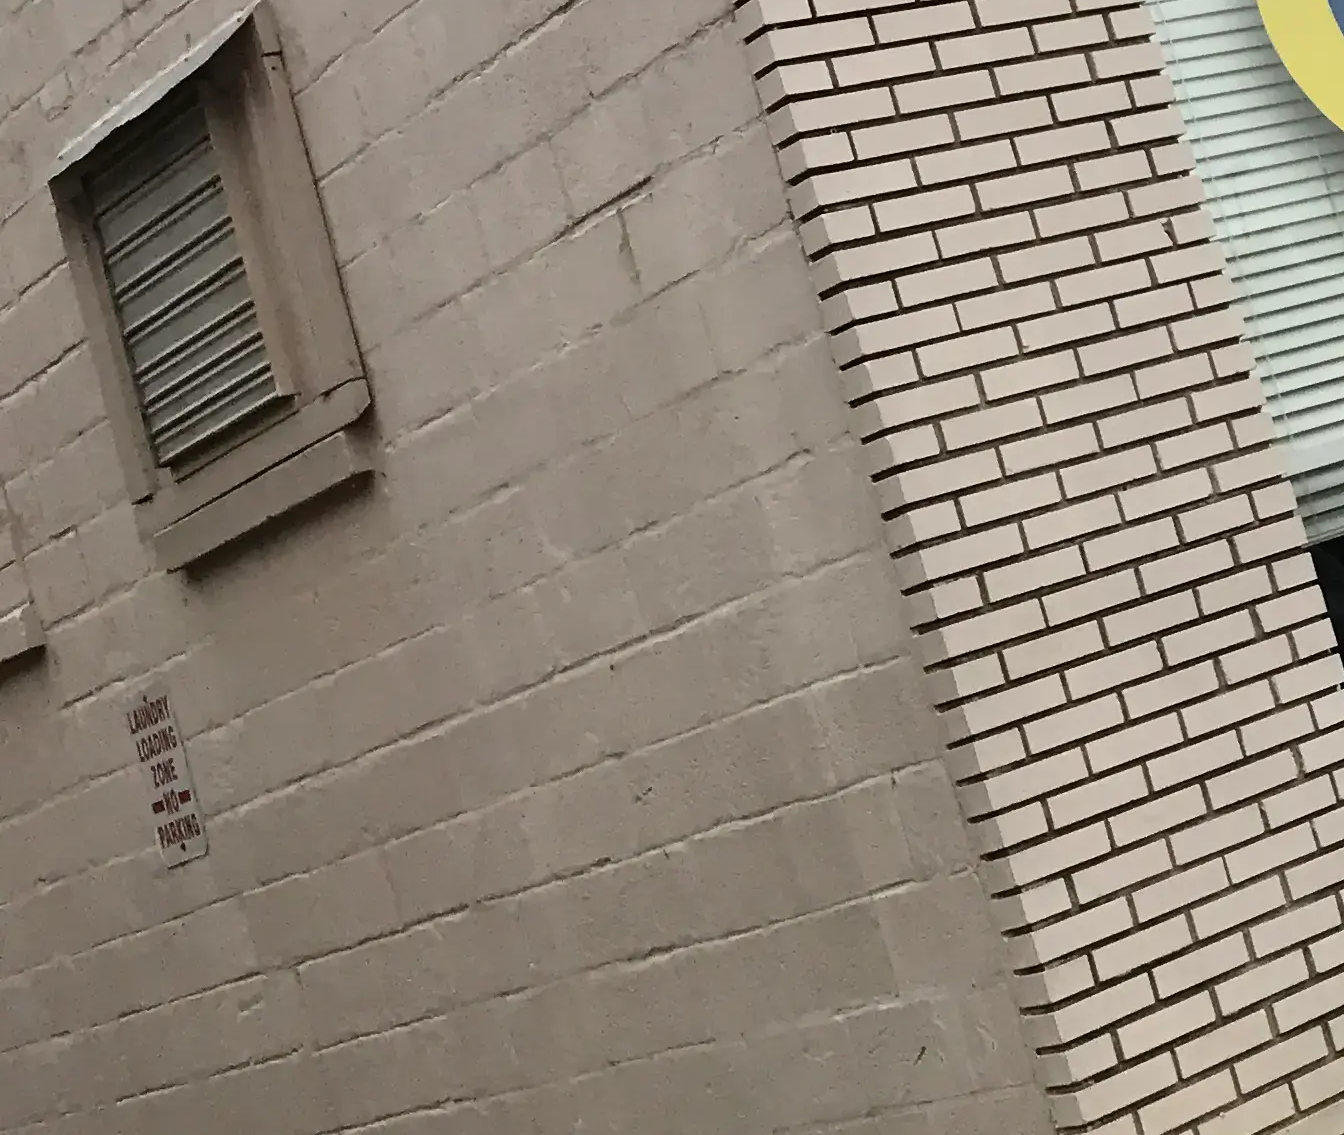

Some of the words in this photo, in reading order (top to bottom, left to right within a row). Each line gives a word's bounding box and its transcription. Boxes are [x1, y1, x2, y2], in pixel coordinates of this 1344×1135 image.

[126, 695, 171, 734] LAUNDRY
[136, 725, 178, 763] LOADING
[150, 757, 179, 789] ZONE
[162, 787, 180, 815] NO
[156, 812, 201, 849] PARKING
